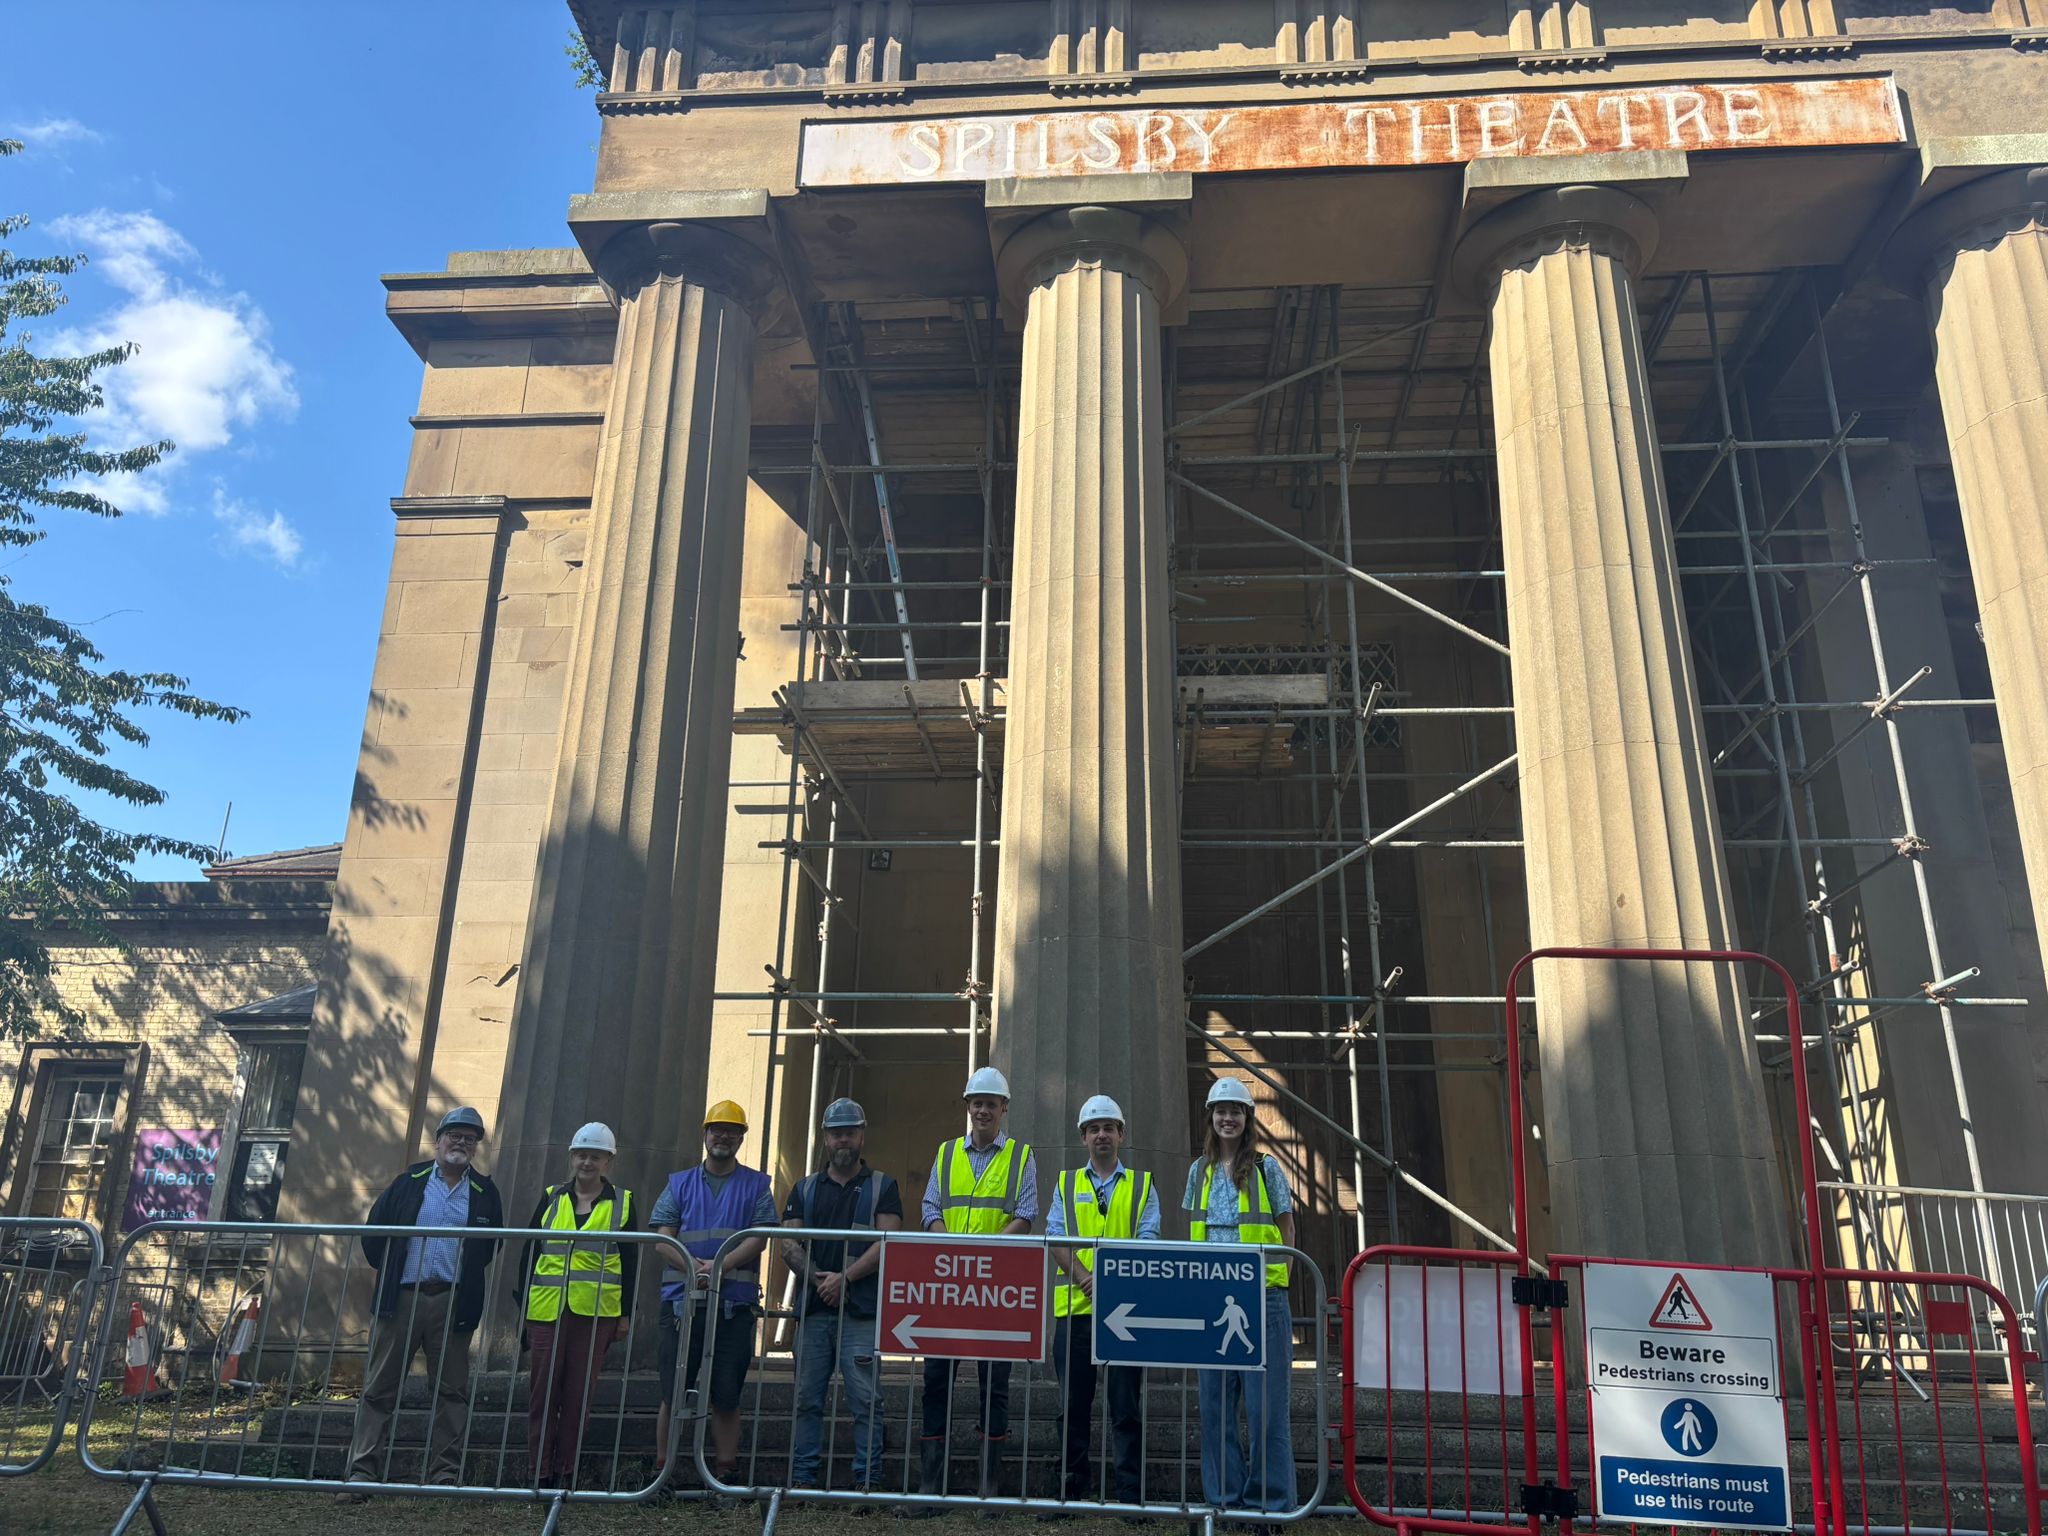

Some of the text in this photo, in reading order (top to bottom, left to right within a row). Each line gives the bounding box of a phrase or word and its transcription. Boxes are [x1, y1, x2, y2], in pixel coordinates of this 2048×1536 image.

[900, 90, 1772, 177] SPILSBY THEATRE
[152, 1143, 219, 1165] Spilsby
[142, 1168, 216, 1186] Theatre
[147, 1209, 196, 1218] entrance
[934, 1254, 993, 1279] SITE
[1103, 1258, 1255, 1282] PEDESTRIANS
[889, 1281, 1037, 1310] ENTRANCE
[1639, 1339, 1726, 1364] Beware
[1598, 1363, 1769, 1390] Pedestrians crossing
[1617, 1468, 1769, 1493] Pedestrians must
[1634, 1493, 1754, 1514] use this route
